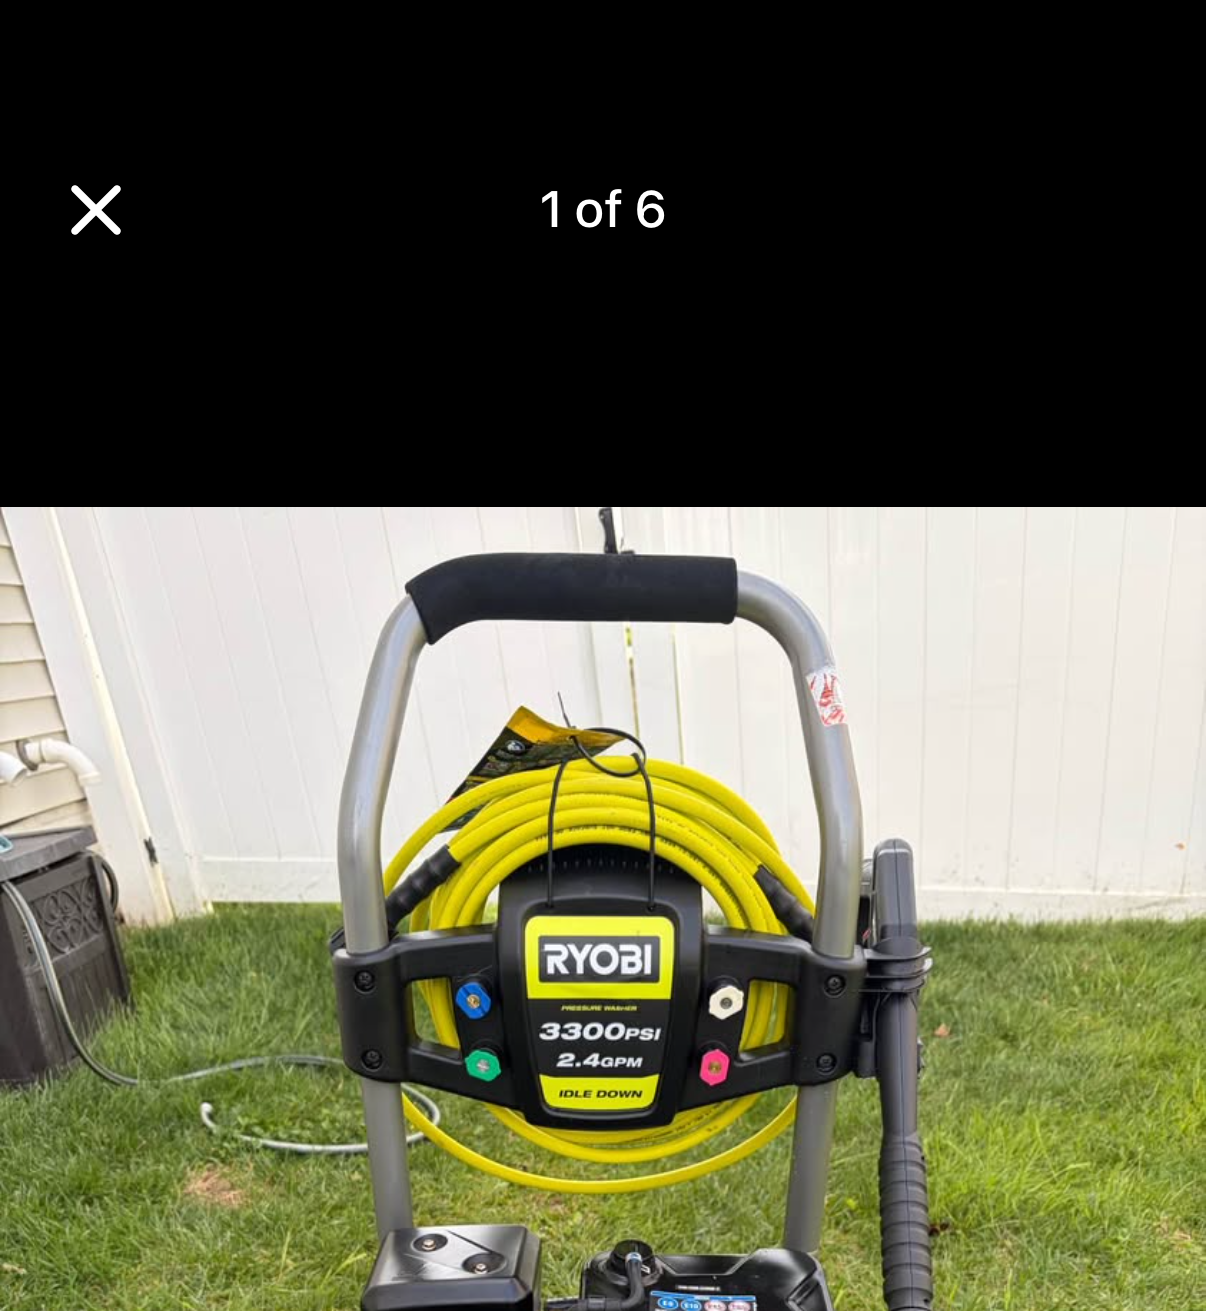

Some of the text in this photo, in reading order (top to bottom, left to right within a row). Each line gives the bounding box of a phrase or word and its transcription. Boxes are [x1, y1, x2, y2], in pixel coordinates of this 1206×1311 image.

[543, 943, 653, 976] RYOBI
[538, 1022, 662, 1041] 3300PSI
[556, 1052, 643, 1068] 2.4GPM
[558, 1089, 643, 1099] IDLE DOWN
